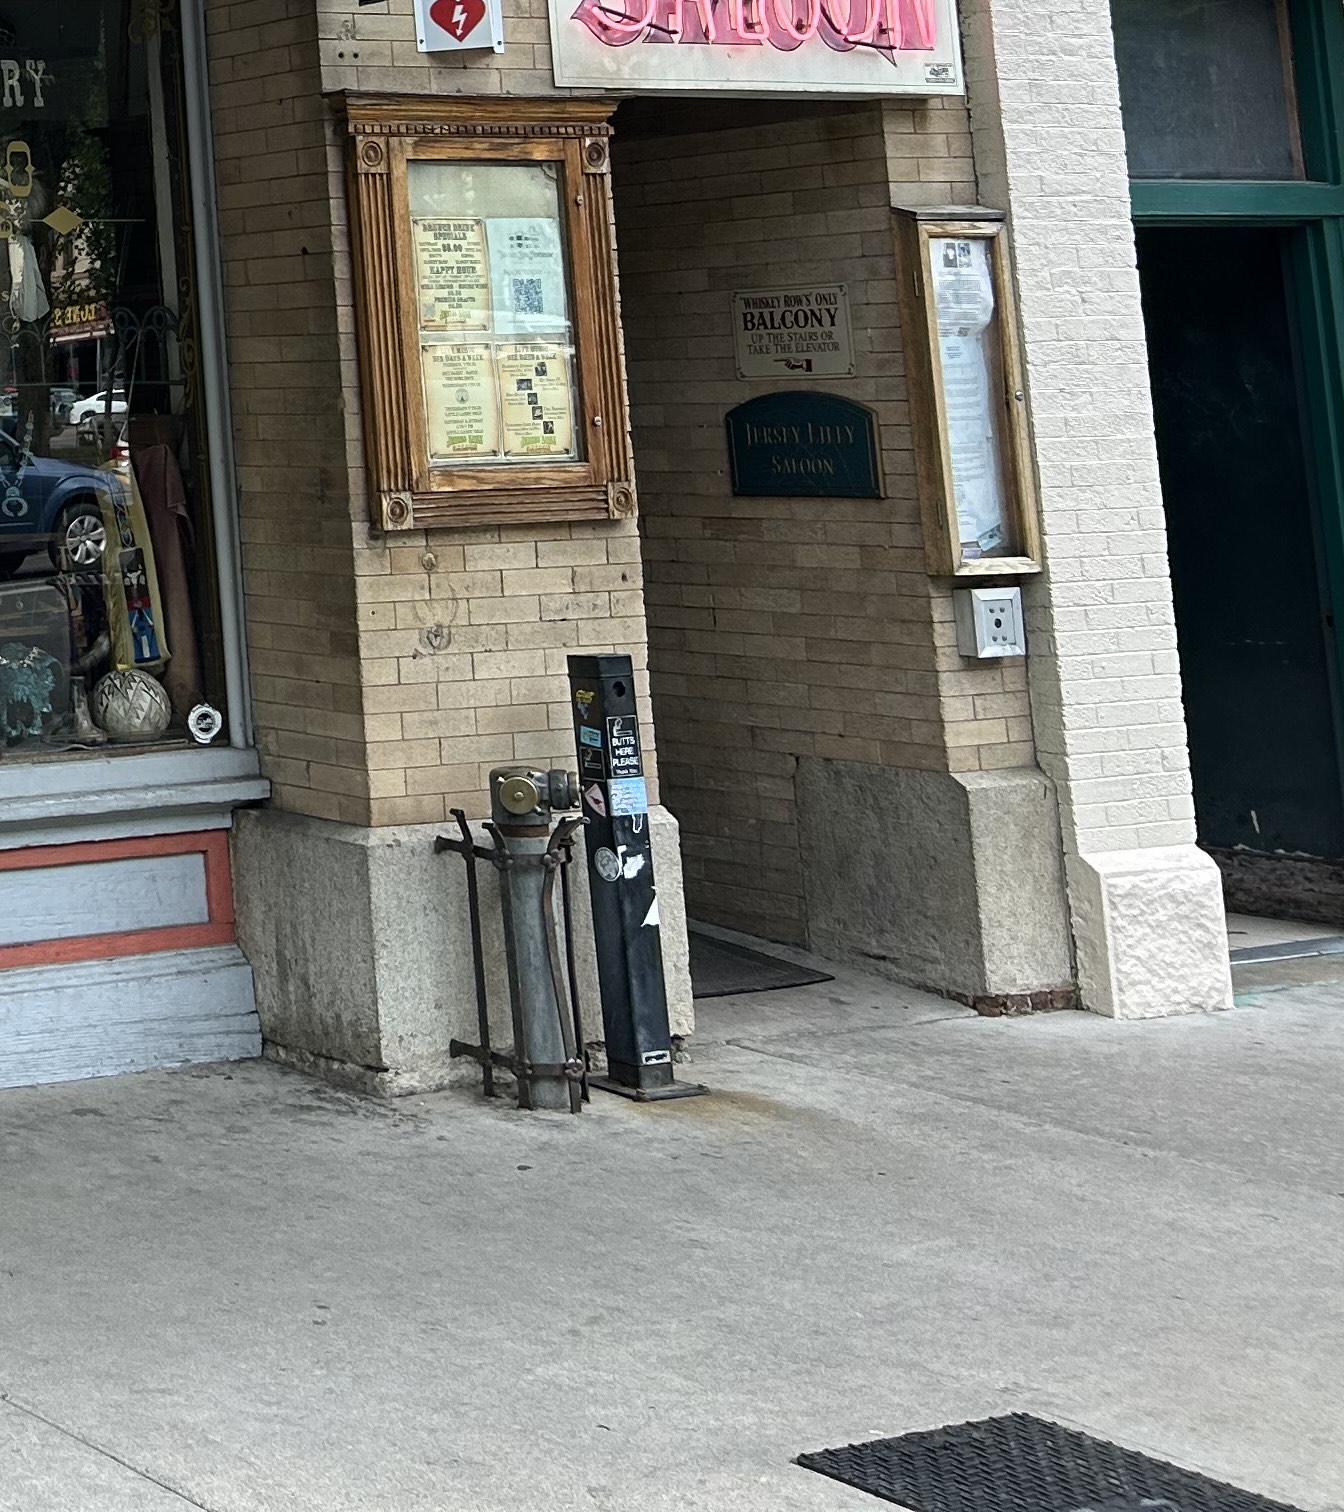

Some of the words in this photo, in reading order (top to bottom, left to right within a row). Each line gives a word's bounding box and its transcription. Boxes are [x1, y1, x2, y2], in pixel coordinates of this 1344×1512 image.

[815, 292, 839, 306] ONLY
[742, 307, 839, 331] BALCONY
[751, 333, 765, 344] UP
[766, 332, 787, 344] THE
[788, 331, 819, 342] STAIRS
[820, 330, 834, 341] OR
[747, 343, 771, 355] TAKE
[774, 343, 794, 354] THE
[795, 341, 841, 353] ELEVATOR
[612, 736, 636, 746] BUTTS
[615, 746, 635, 756] HERE
[612, 756, 639, 767] PLEASE
